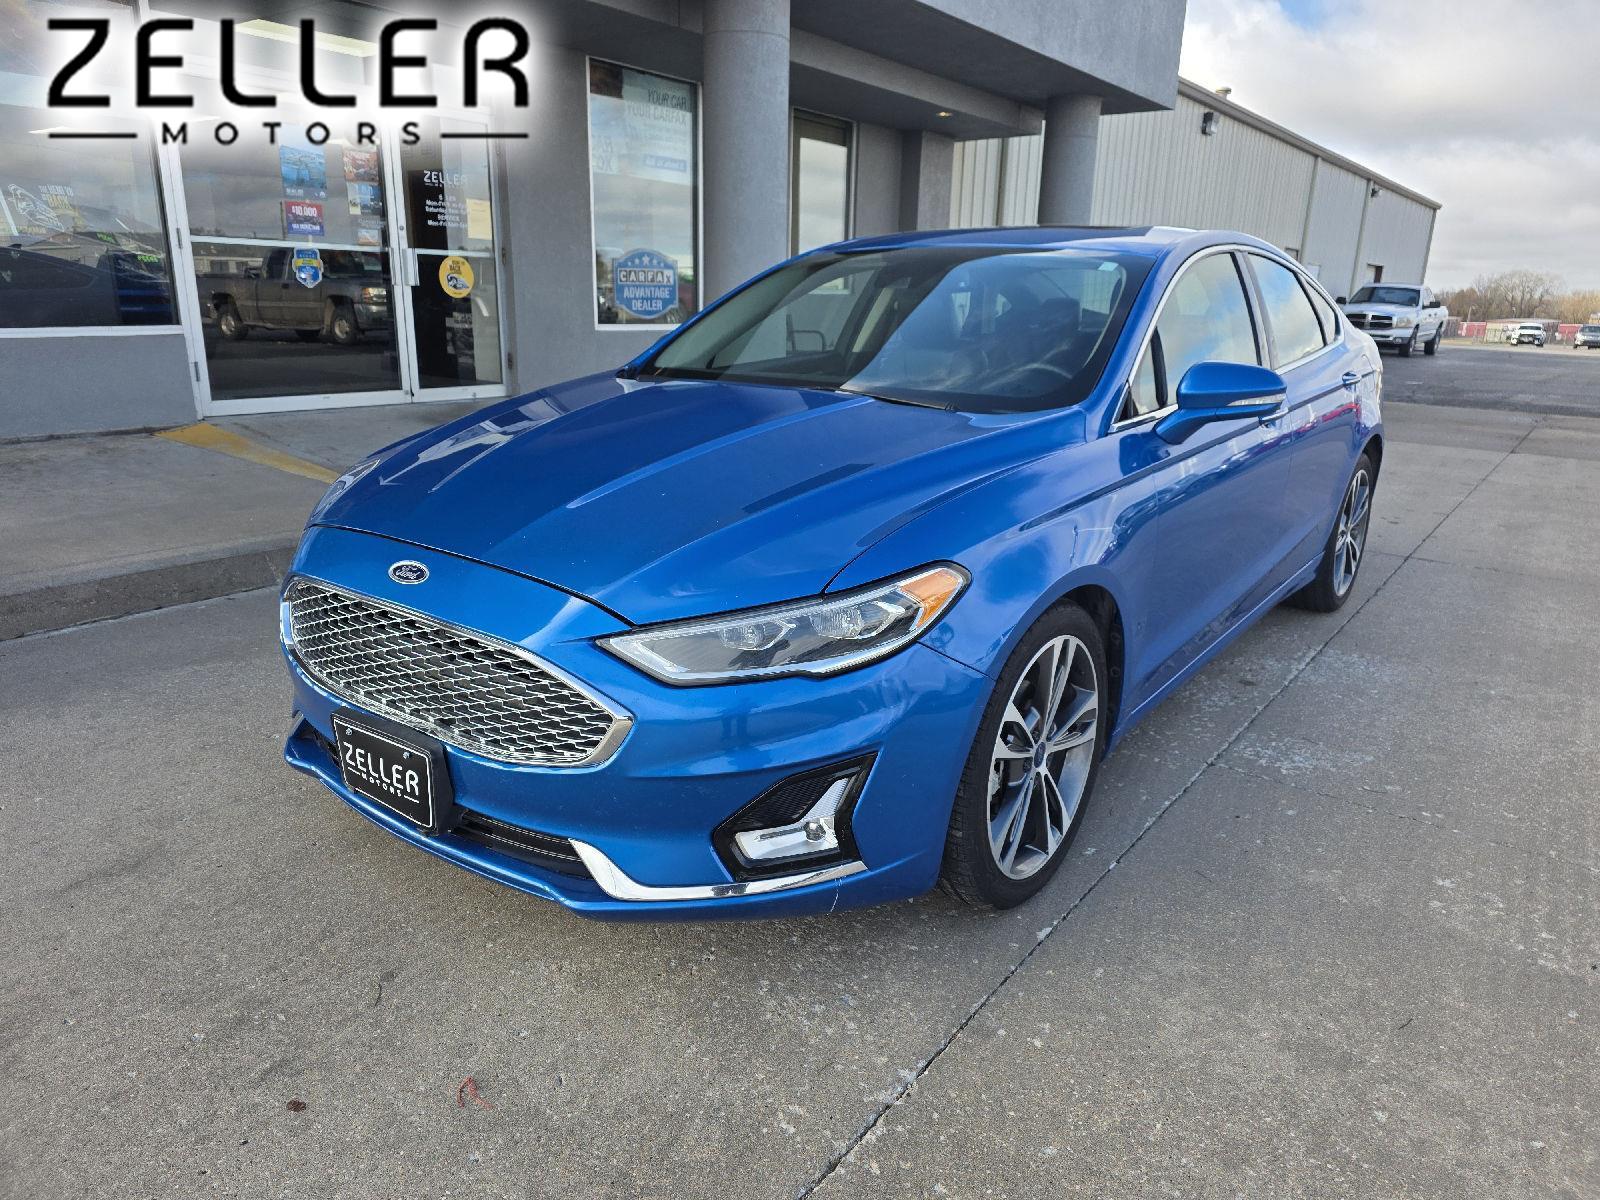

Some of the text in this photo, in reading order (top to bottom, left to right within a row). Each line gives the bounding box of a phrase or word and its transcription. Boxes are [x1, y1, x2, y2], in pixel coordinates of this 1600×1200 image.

[423, 169, 469, 186] ZELLER
[620, 268, 672, 284] CARFAX
[623, 286, 670, 299] ADVANTAGE
[631, 299, 663, 311] DEALER
[343, 741, 419, 796] ZELLER
[361, 772, 402, 797] MOTORS
